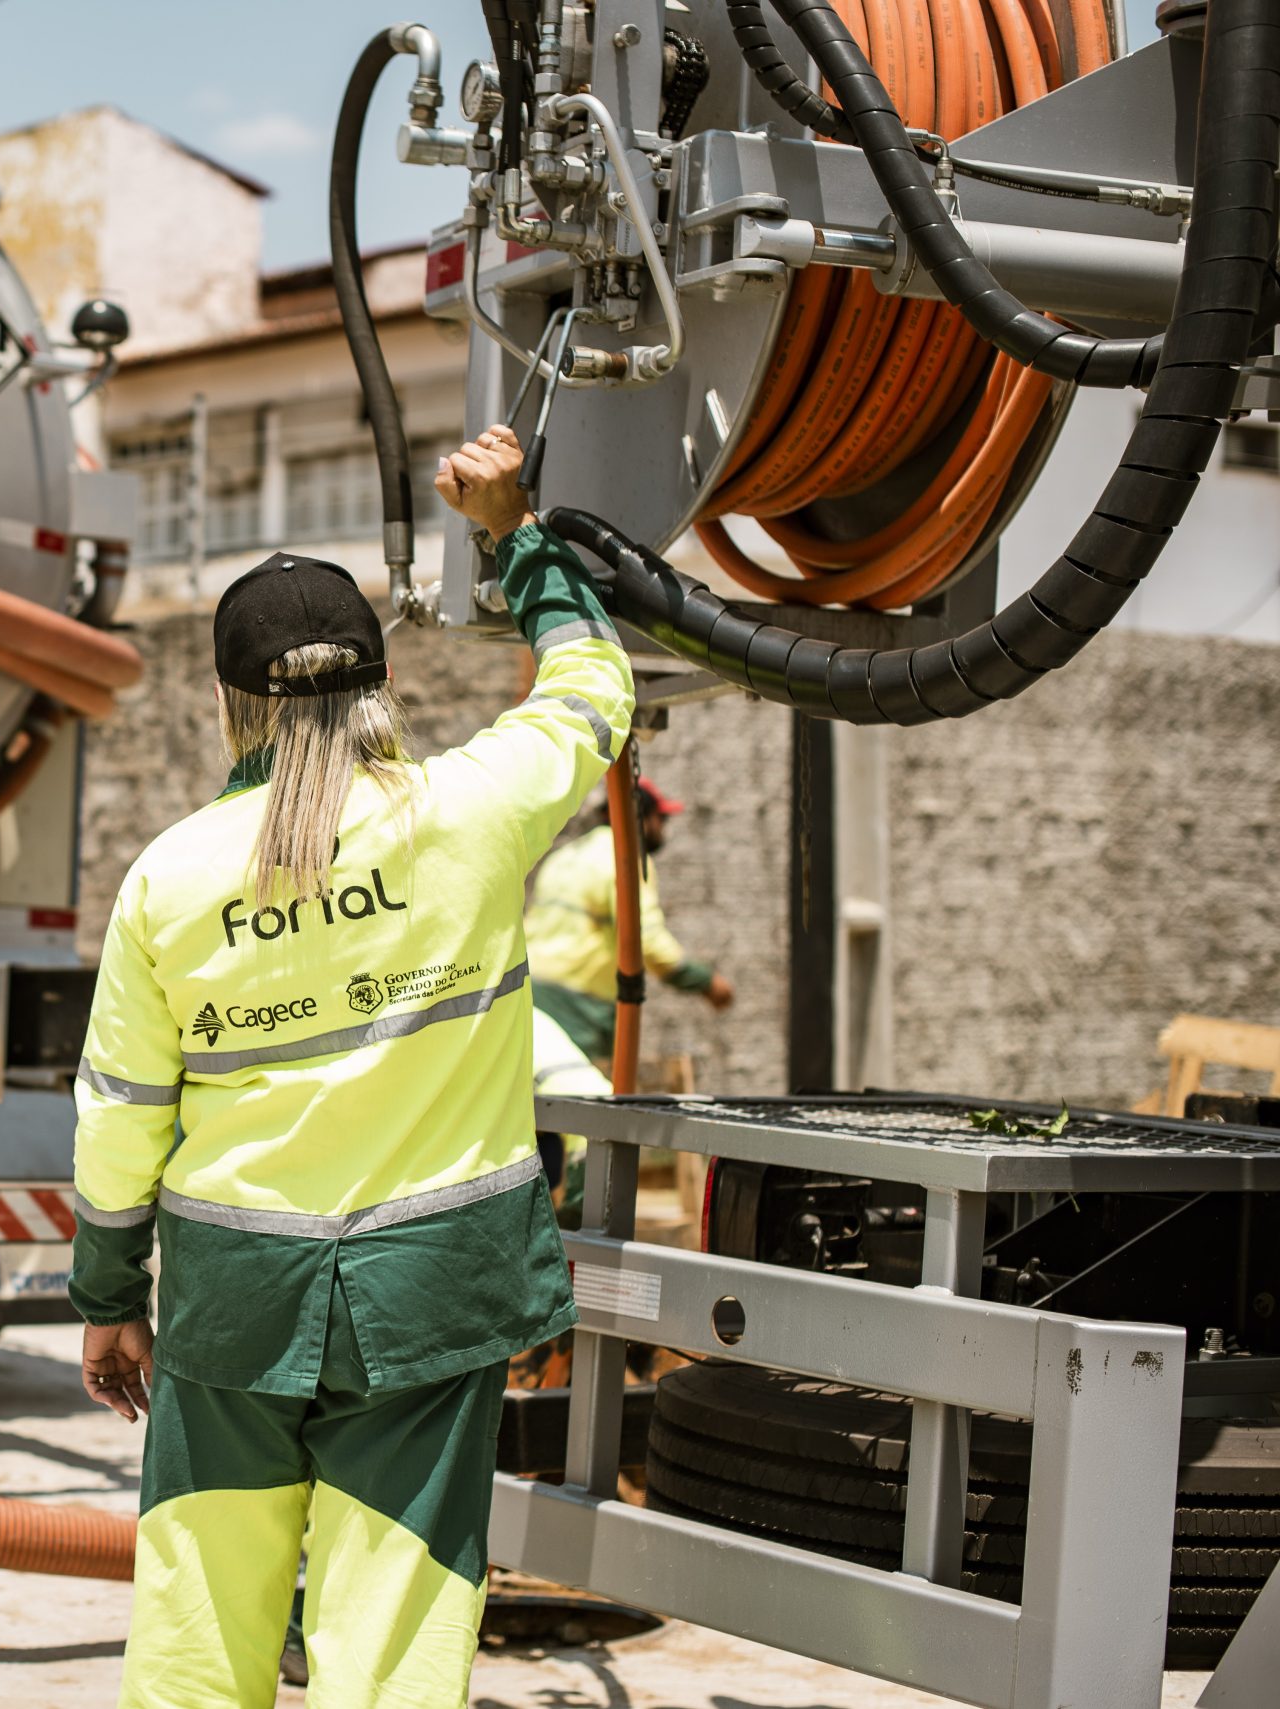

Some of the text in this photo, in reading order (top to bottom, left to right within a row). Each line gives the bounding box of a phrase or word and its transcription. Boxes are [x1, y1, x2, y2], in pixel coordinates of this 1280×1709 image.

[384, 965, 442, 985] GOVERNO
[386, 979, 432, 998] ESTADO
[388, 993, 421, 1005] Secretaria
[422, 990, 434, 998] das
[225, 997, 318, 1032] Cagece
